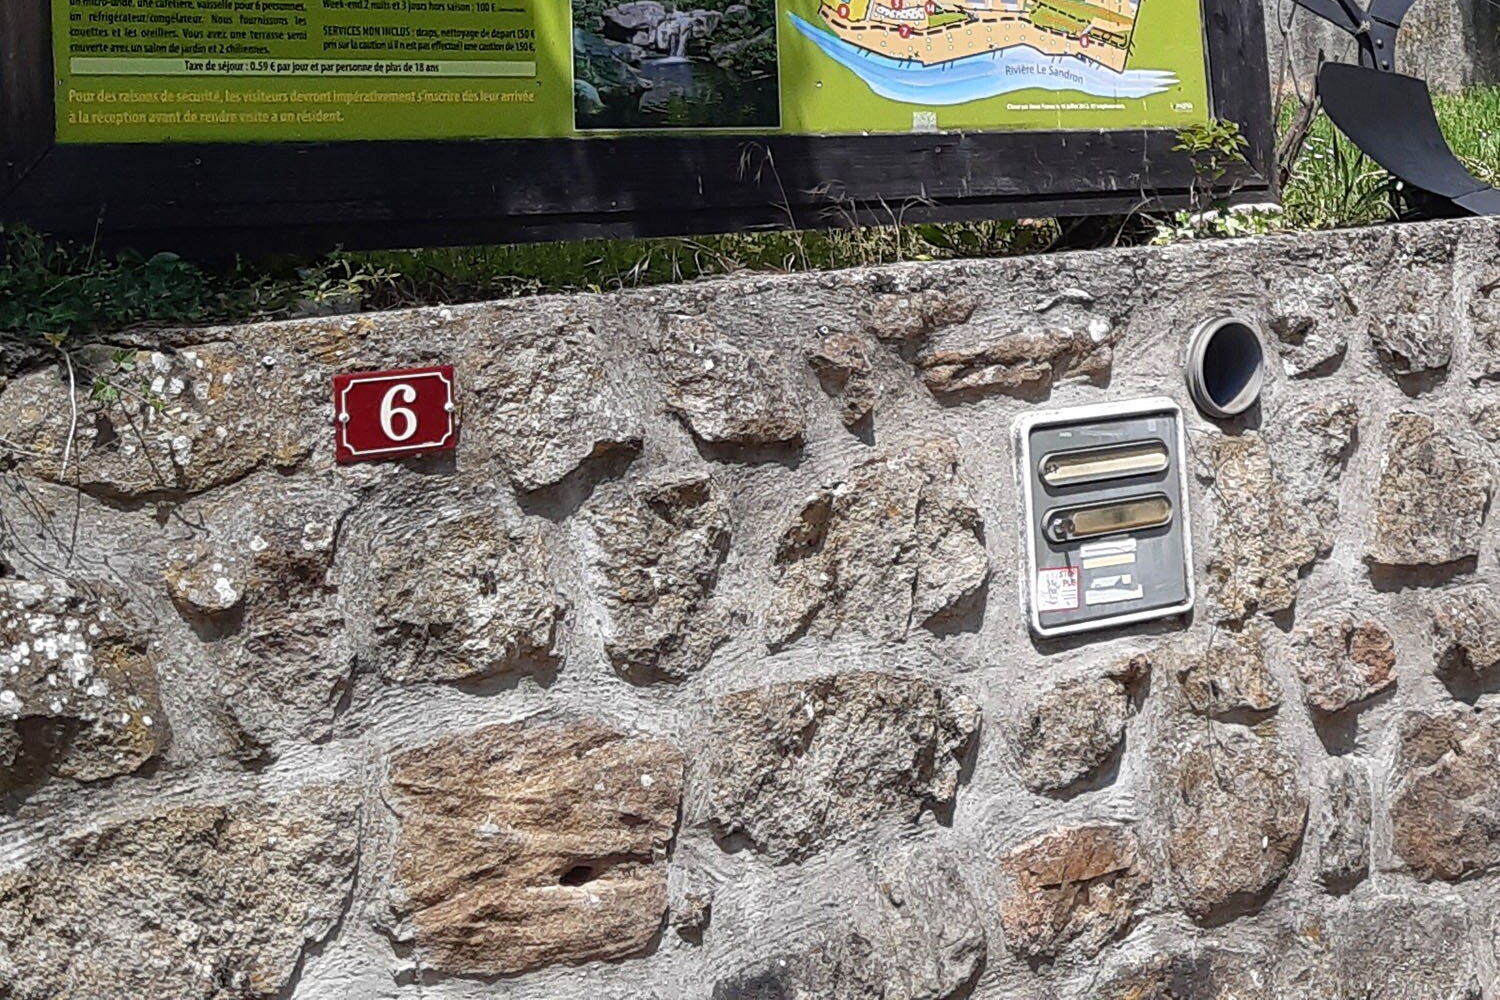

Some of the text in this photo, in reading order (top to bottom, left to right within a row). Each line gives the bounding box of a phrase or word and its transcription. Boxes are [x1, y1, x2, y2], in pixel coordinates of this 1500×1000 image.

[1005, 65, 1084, 84] Rivière Le Sandron
[380, 384, 417, 441] 6
